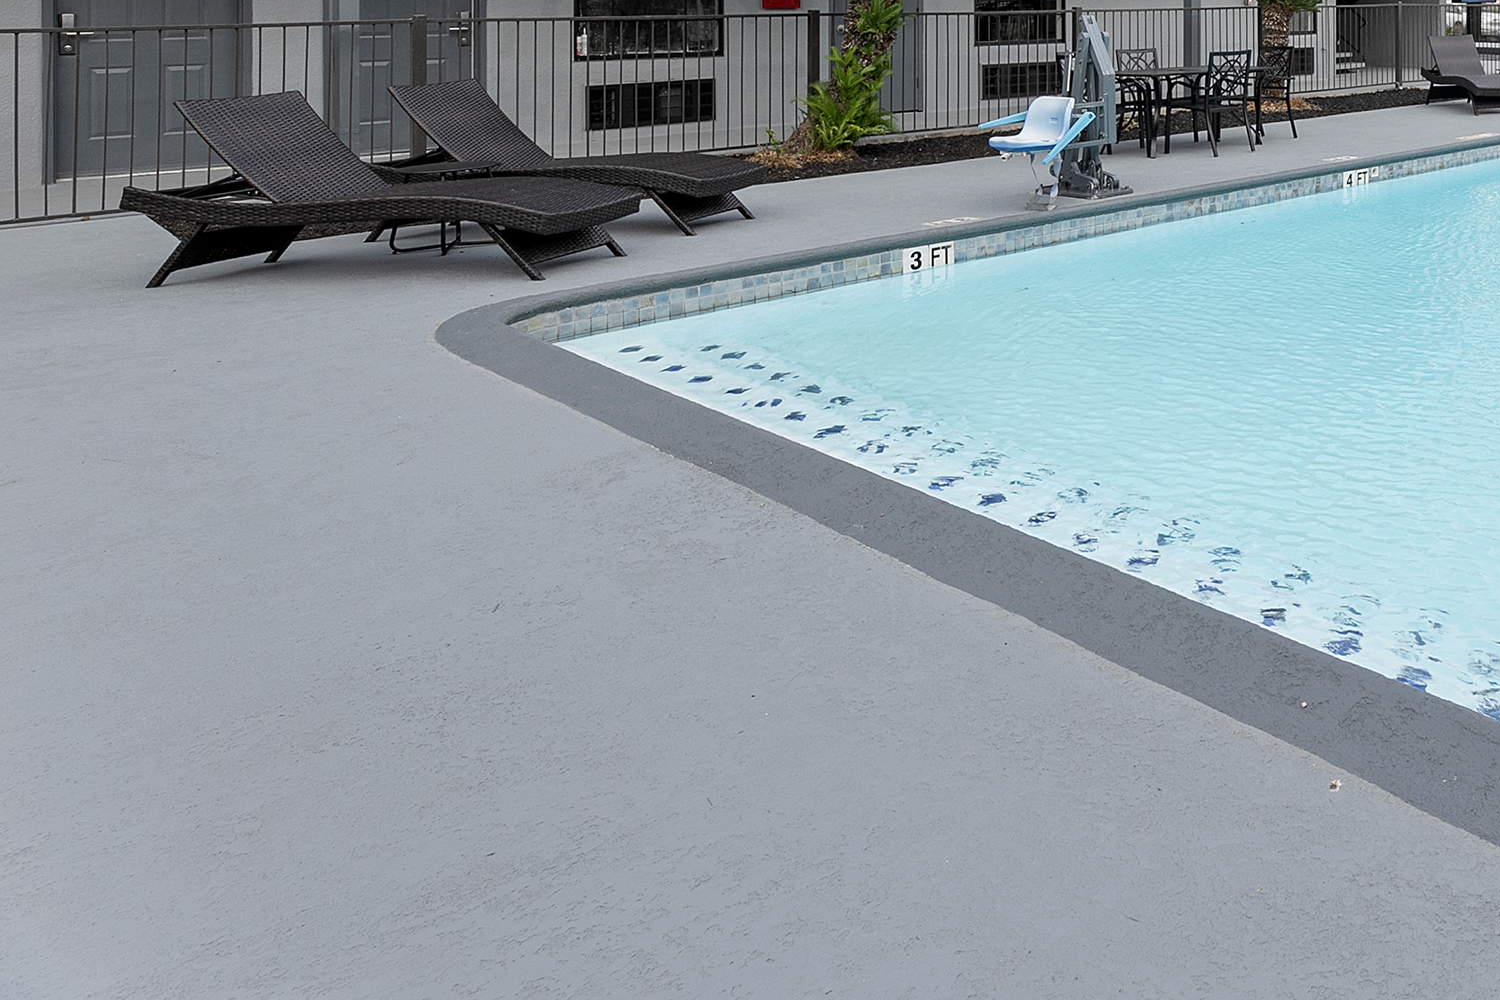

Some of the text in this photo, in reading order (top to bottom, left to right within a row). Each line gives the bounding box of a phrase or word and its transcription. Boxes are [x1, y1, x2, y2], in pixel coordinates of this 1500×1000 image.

[1346, 172, 1367, 187] 4 FT
[910, 245, 952, 270] 3 FT
